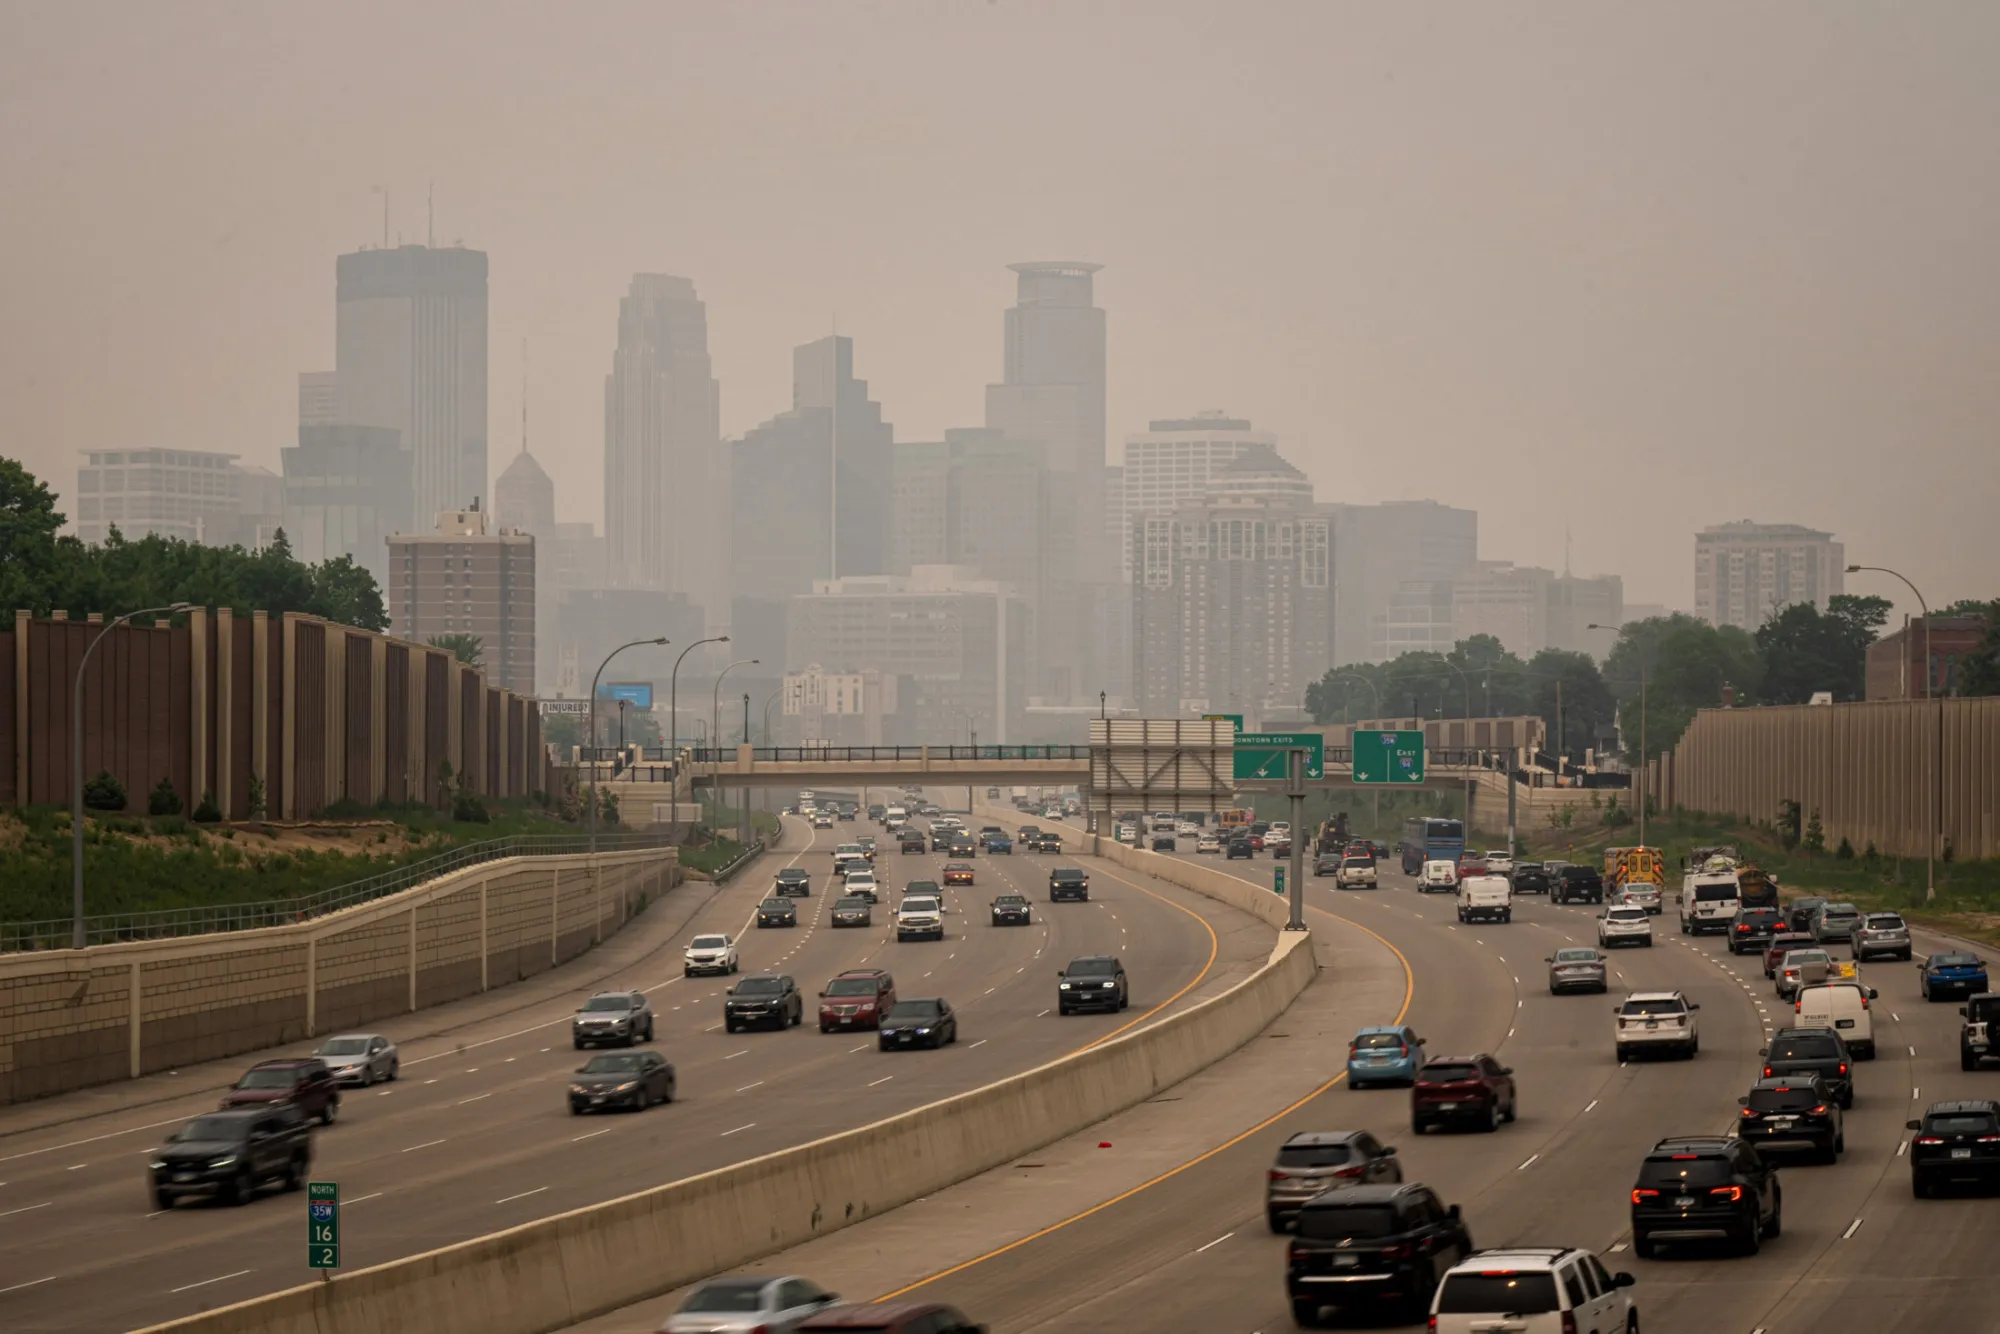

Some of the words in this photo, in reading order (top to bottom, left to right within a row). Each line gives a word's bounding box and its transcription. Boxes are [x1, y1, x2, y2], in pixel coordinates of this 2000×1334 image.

[549, 703, 588, 713] INJURED?
[311, 1185, 334, 1195] NORTH
[313, 1206, 332, 1216] 35W
[316, 1225, 332, 1242] 16
[317, 1248, 333, 1264] .2
